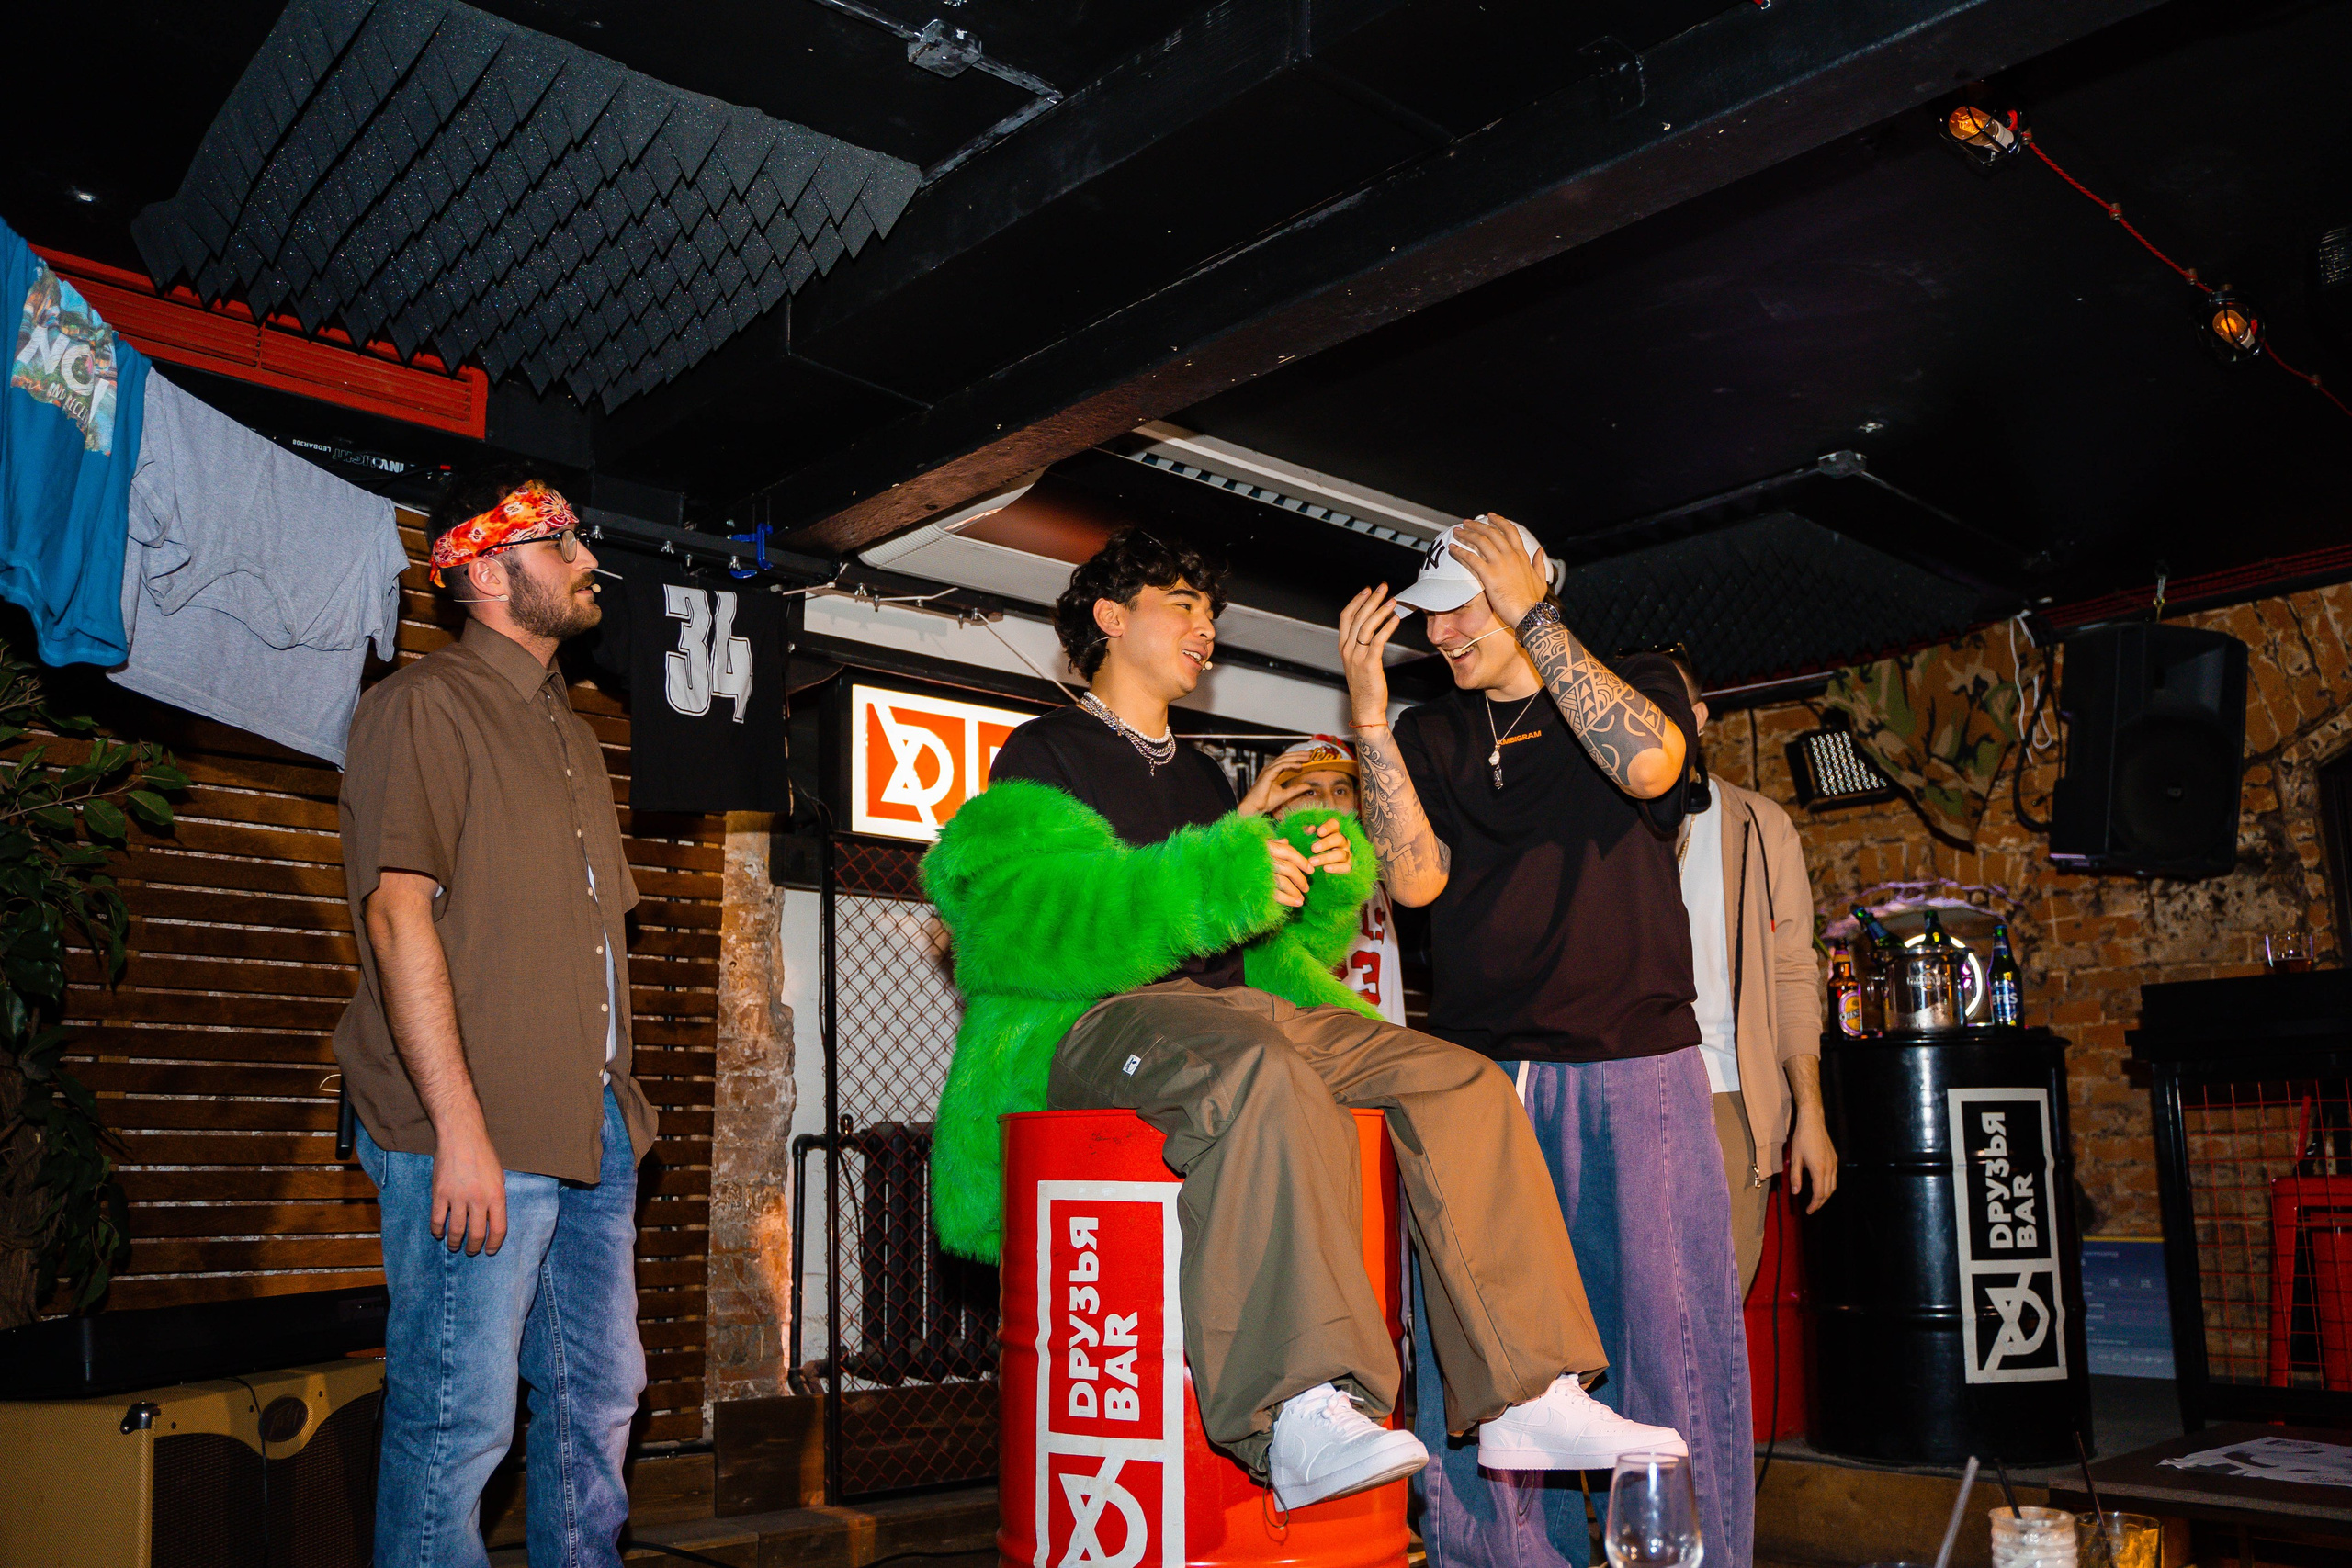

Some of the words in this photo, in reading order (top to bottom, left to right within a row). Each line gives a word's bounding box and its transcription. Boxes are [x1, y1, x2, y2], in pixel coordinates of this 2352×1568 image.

[663, 583, 753, 724] 34
[1497, 730, 1543, 746] AMBIGRAM
[2012, 1172, 2038, 1248] BAR
[1103, 1311, 1140, 1422] BAR
